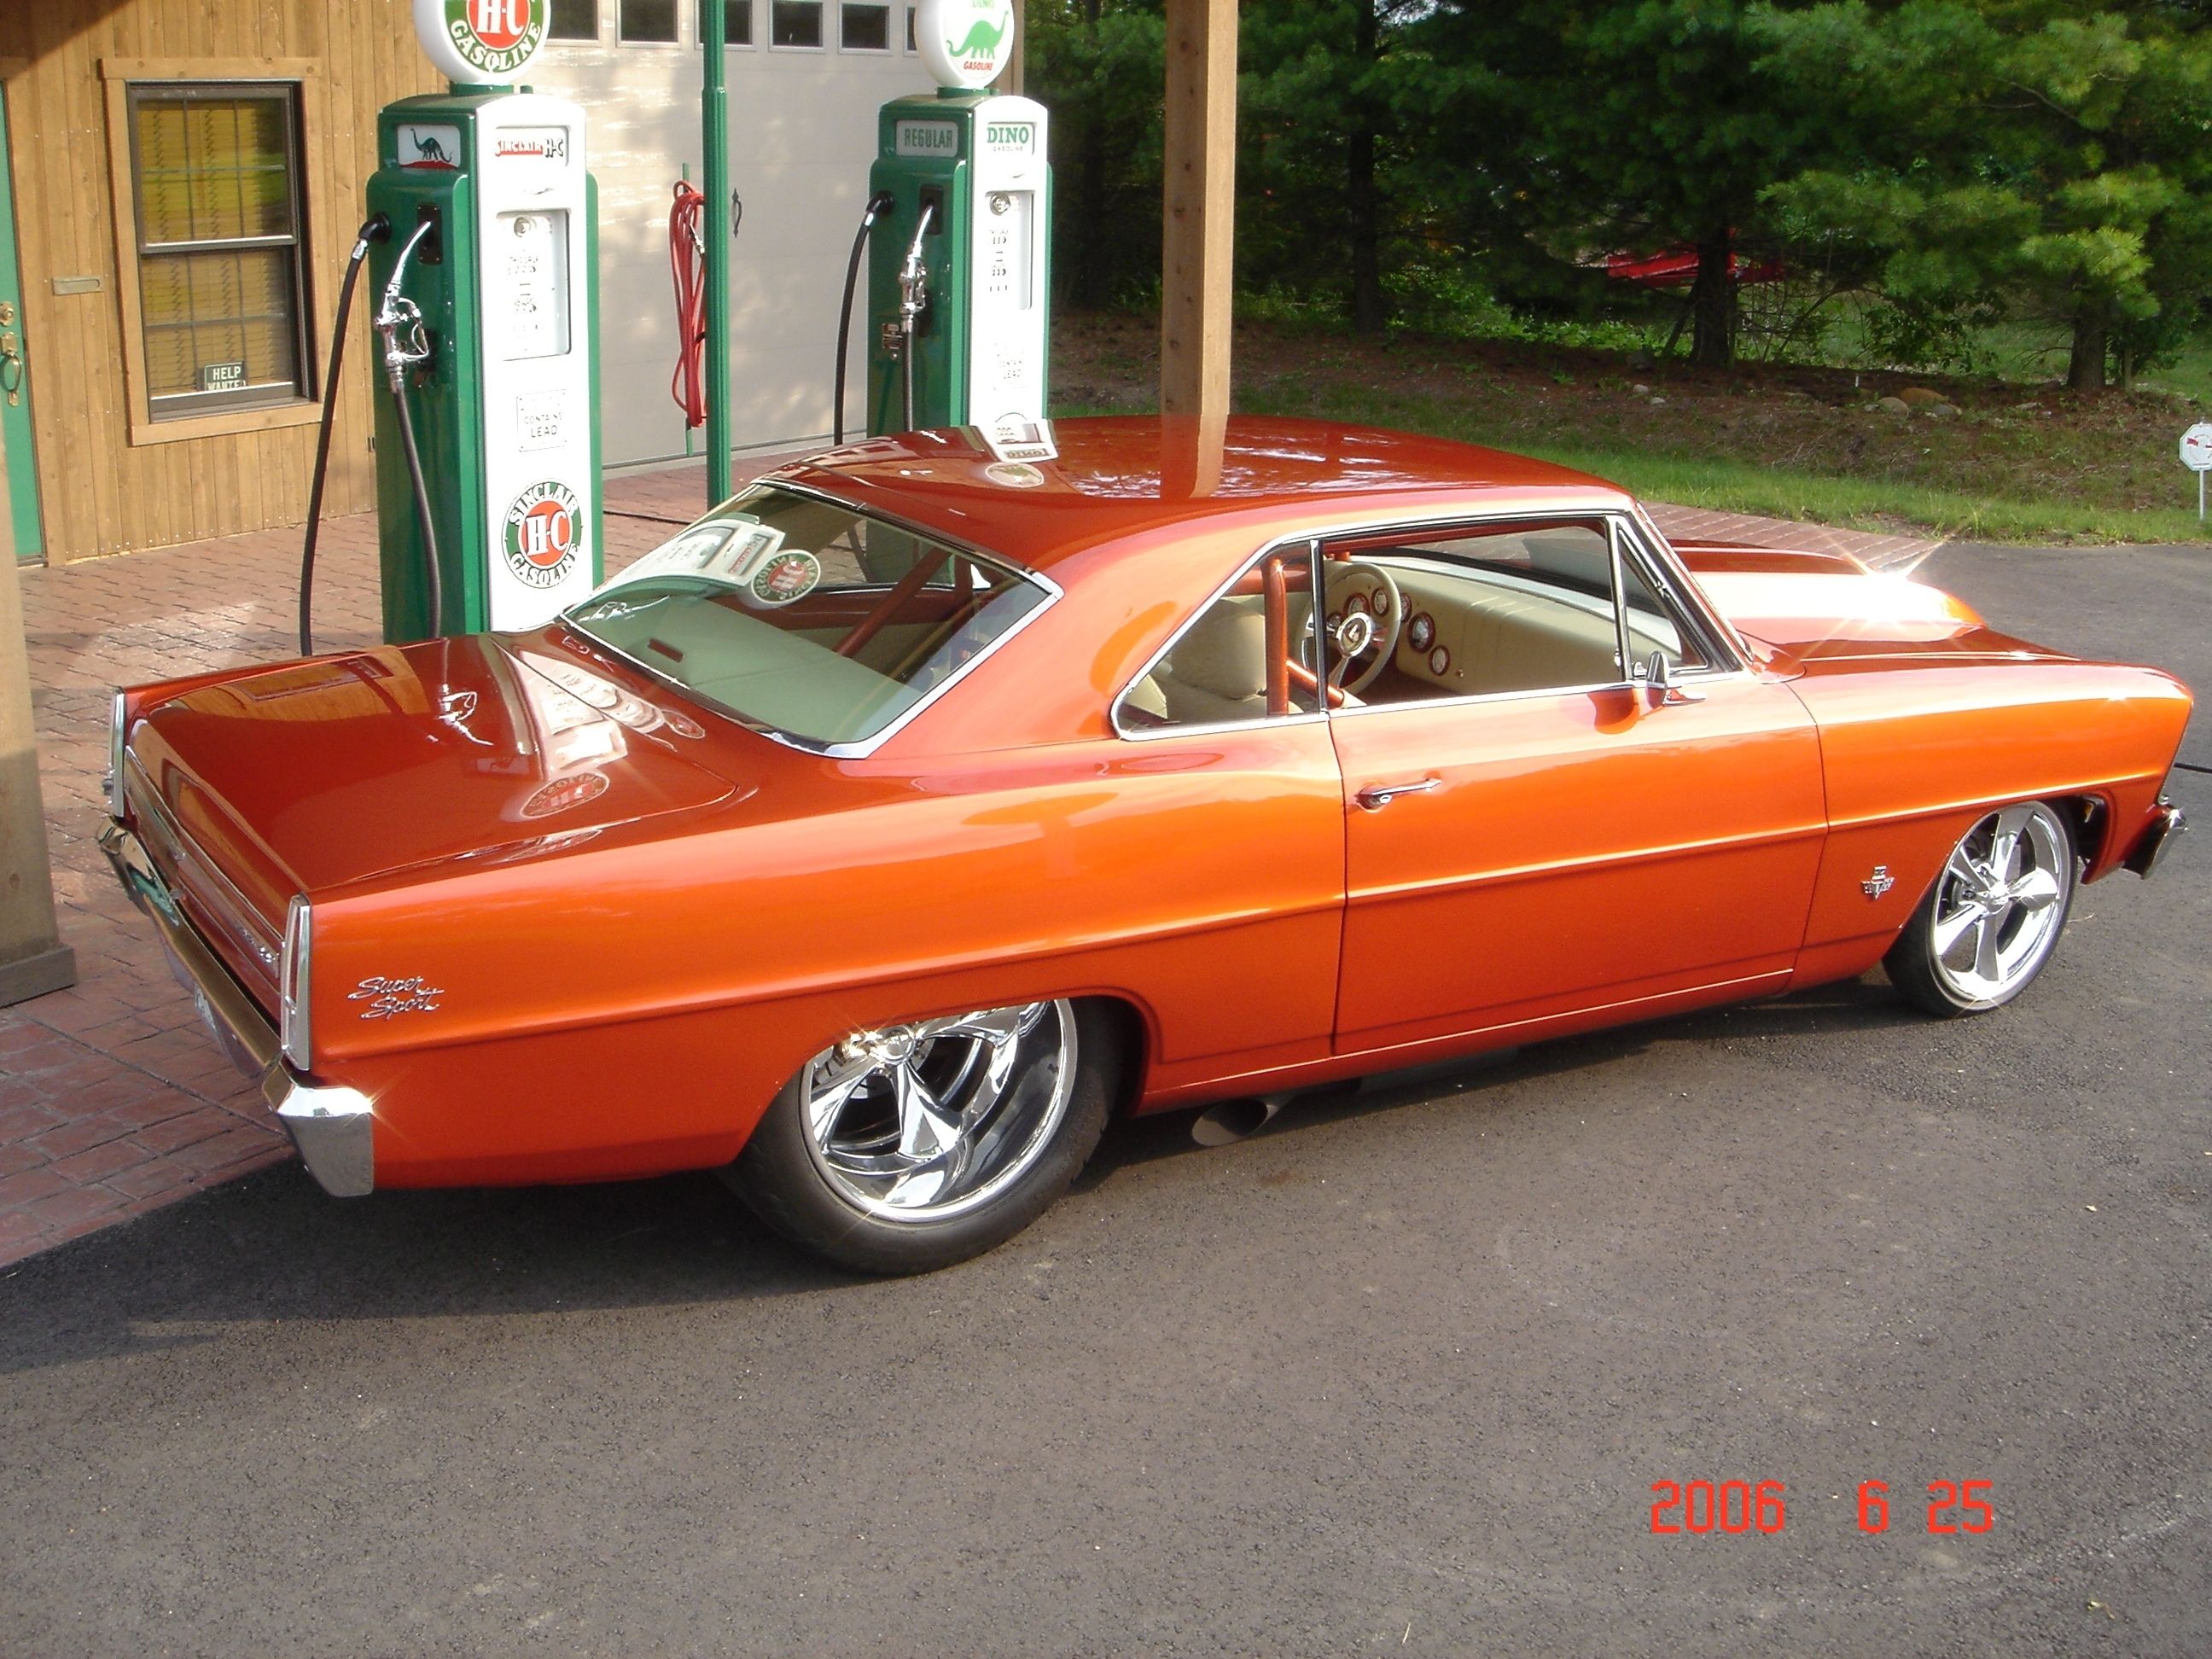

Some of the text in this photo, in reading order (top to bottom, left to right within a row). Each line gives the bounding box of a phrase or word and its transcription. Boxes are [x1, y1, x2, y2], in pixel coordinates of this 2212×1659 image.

[451, 20, 541, 73] GASOLINE
[963, 61, 993, 71] GASOLINE
[905, 128, 953, 148] REGULAR
[987, 126, 1029, 144] DINO
[494, 138, 544, 158] SINCLAIR
[212, 365, 242, 381] HELP
[524, 411, 562, 425] CONTANS
[531, 424, 558, 439] LEAD
[509, 480, 579, 527] SINCLAIR
[347, 975, 424, 999] Super
[360, 987, 445, 1021] Sport
